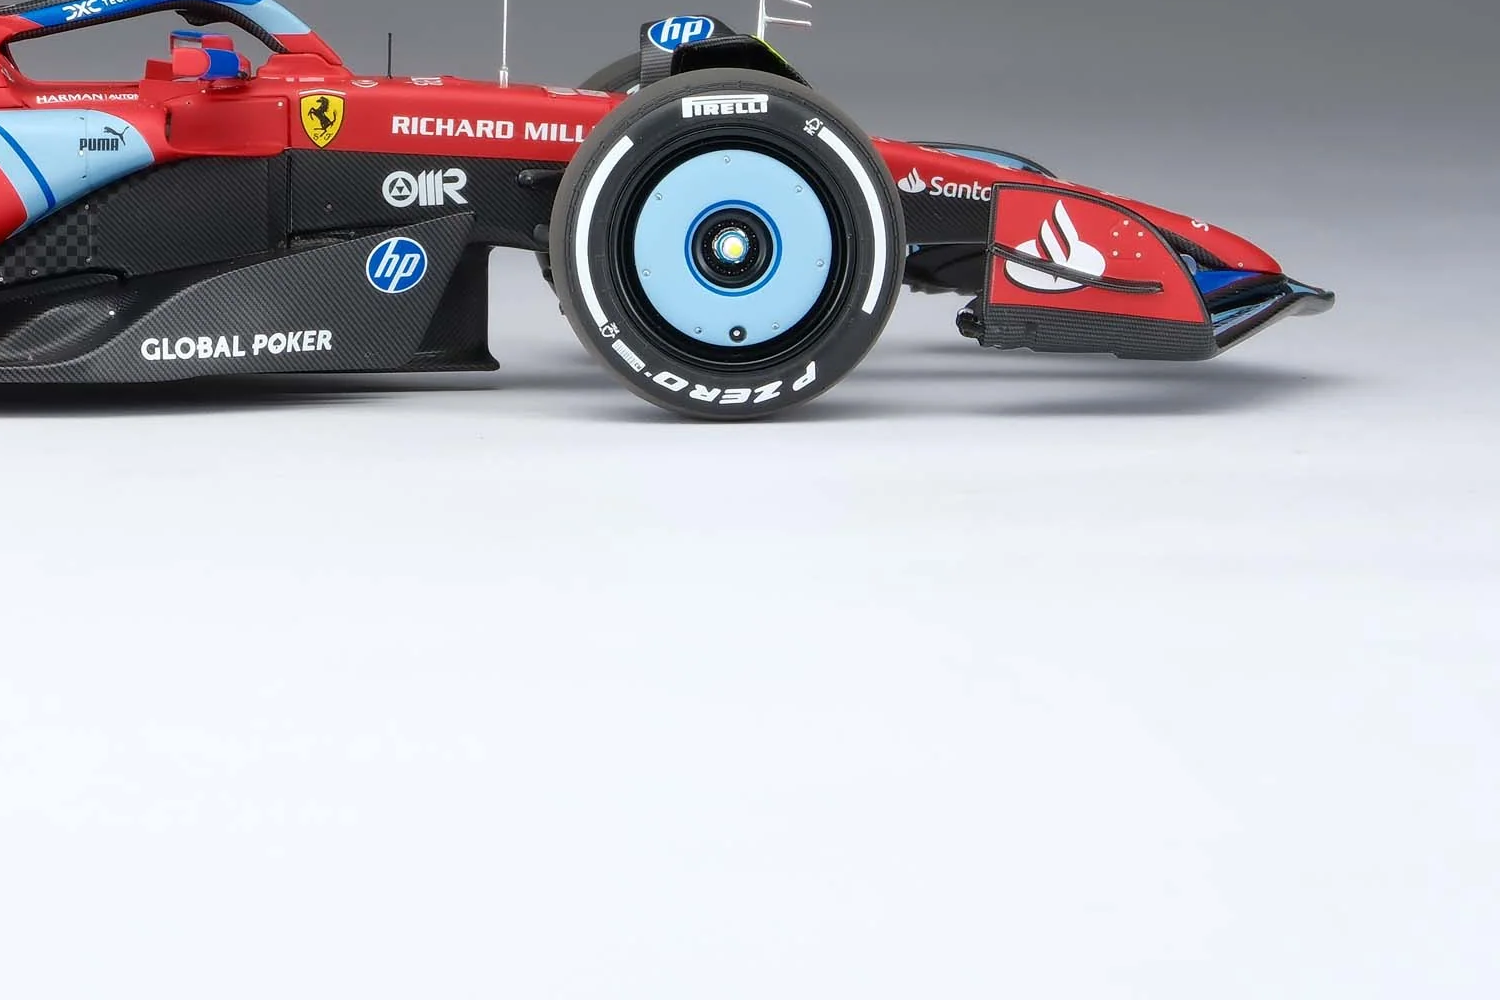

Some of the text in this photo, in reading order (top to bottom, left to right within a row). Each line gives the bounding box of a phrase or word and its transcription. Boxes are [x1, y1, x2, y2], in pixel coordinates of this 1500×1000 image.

[62, 0, 102, 21] DXC
[660, 17, 704, 44] hp
[36, 93, 103, 105] HARMAN
[681, 94, 769, 119] PIRELLI
[391, 115, 596, 144] RICHARD MILL
[79, 138, 119, 151] PUMA
[373, 237, 422, 294] hp
[141, 329, 333, 362] GLOBAL POKER
[652, 360, 816, 405] P ZERO
